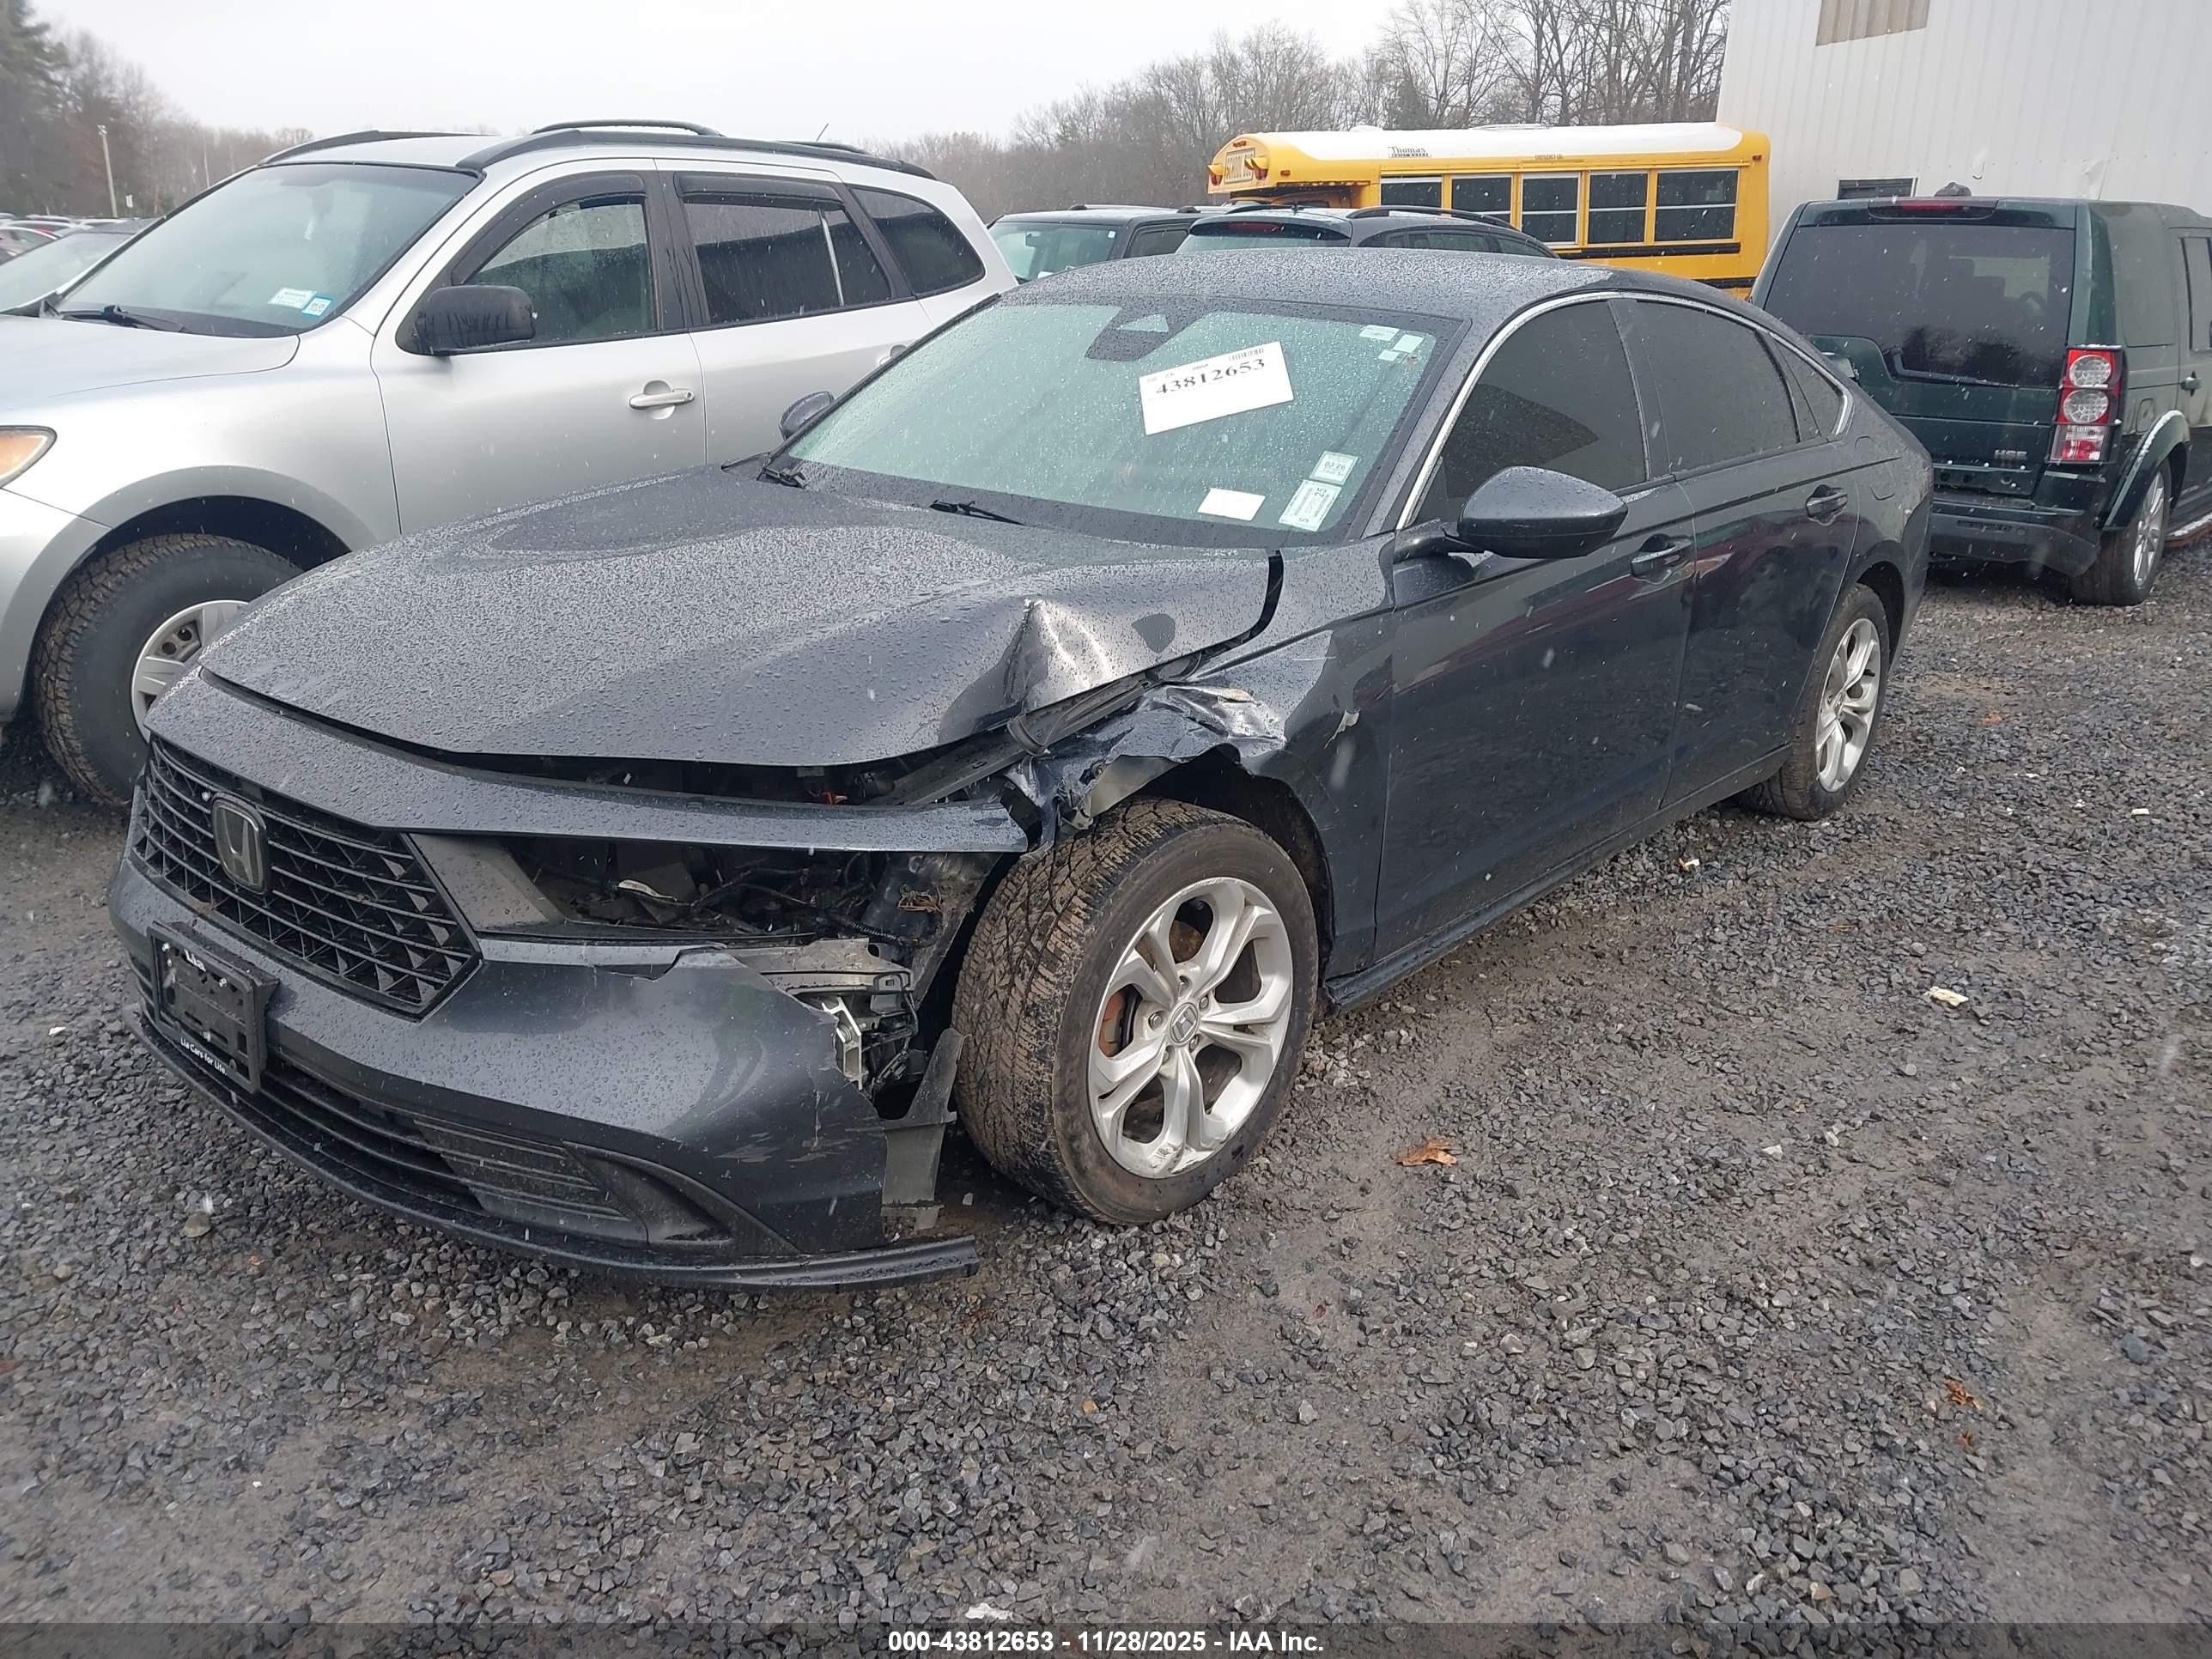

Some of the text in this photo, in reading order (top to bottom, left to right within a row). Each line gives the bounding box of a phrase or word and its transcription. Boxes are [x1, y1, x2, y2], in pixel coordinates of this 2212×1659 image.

[1156, 358, 1265, 394] 43812653
[1994, 449, 2027, 460] HSE
[180, 1036, 190, 1048] Lia
[190, 1043, 204, 1059] Cars
[204, 1053, 214, 1066] for
